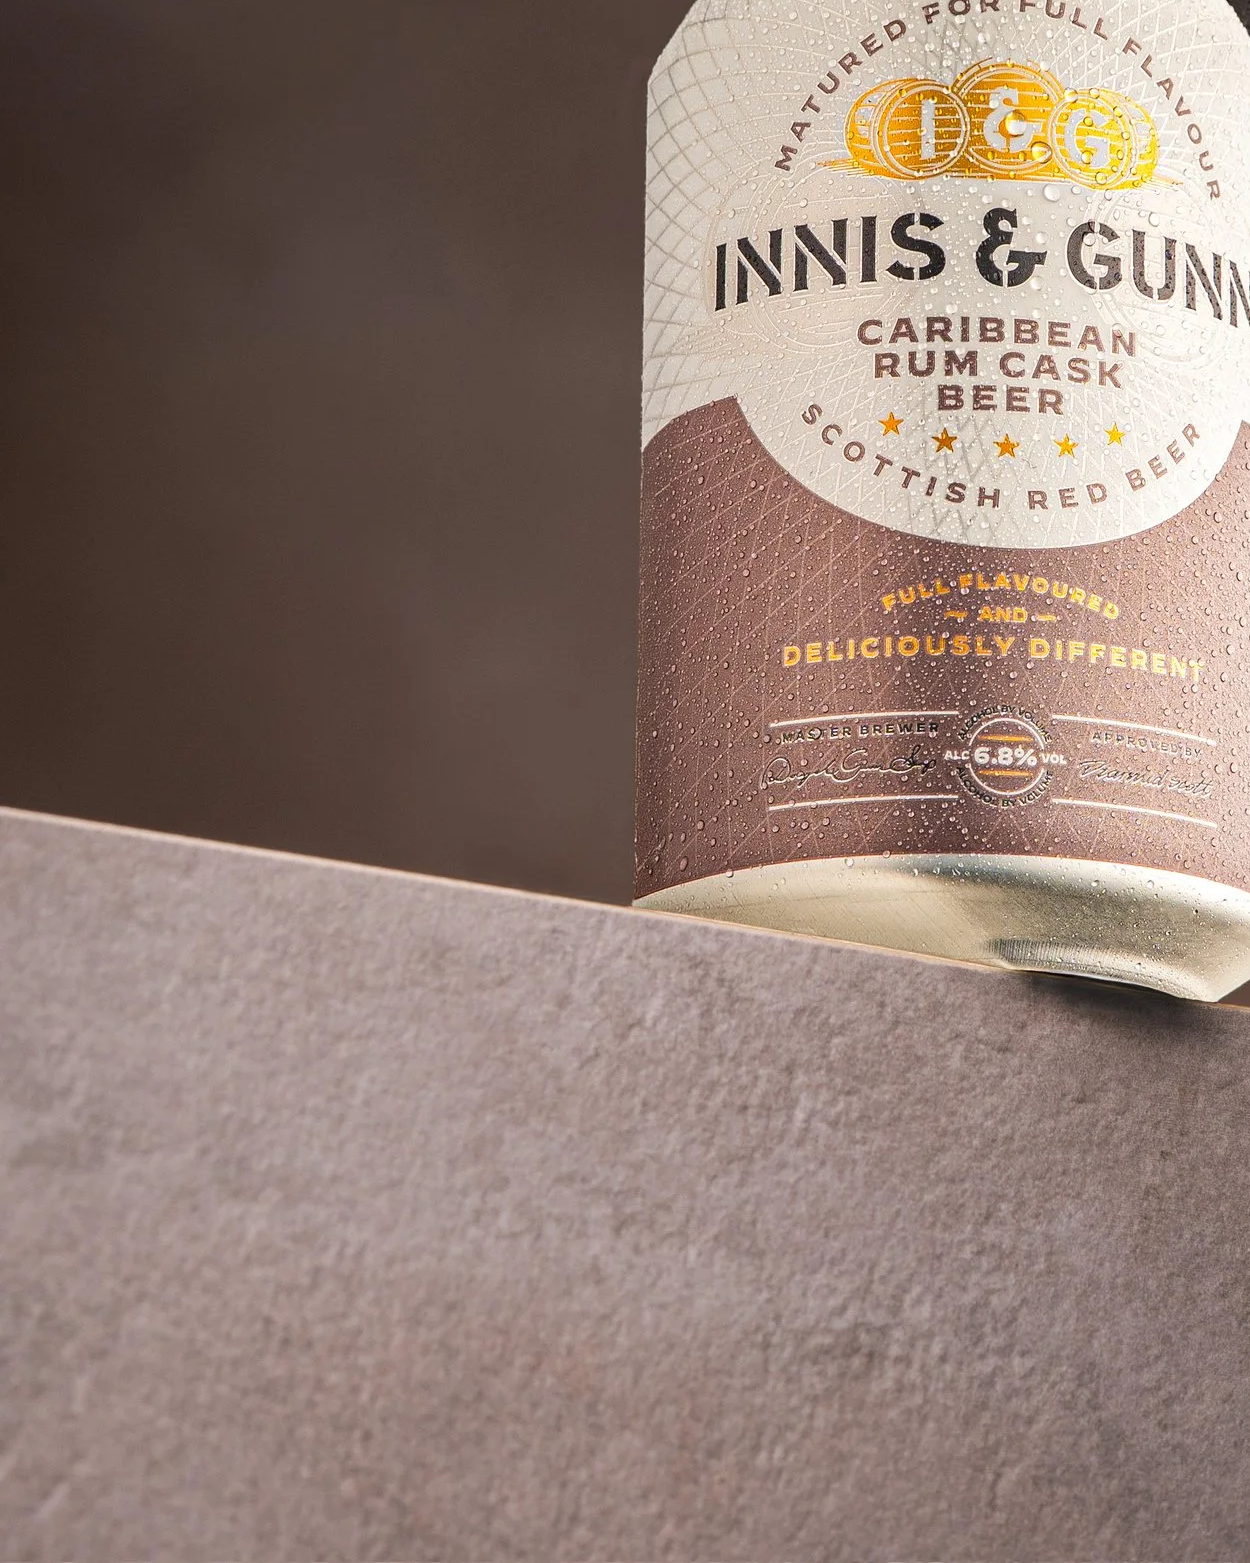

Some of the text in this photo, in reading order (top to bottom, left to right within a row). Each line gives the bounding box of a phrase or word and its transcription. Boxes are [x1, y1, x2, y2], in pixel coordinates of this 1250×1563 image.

[775, 19, 907, 172] MATURED
[1122, 38, 1221, 201] FLAVOUR
[714, 212, 946, 311] INNIS
[976, 207, 1048, 287] &
[857, 316, 1137, 357] CARIBBEAN
[874, 350, 1122, 388] RUM CASK
[937, 384, 1064, 415] BEER
[802, 403, 1200, 510] SCOTTISH RED BEER
[882, 573, 1120, 619] FULL FLAVOURED
[978, 605, 1029, 623] AND
[782, 635, 1203, 682] DELICIOUSLY DIFFERENT
[781, 721, 940, 745] MASTER BREWER
[1091, 731, 1202, 758] APPROVED BY
[943, 746, 1067, 766] ALC 6.8% VOL
